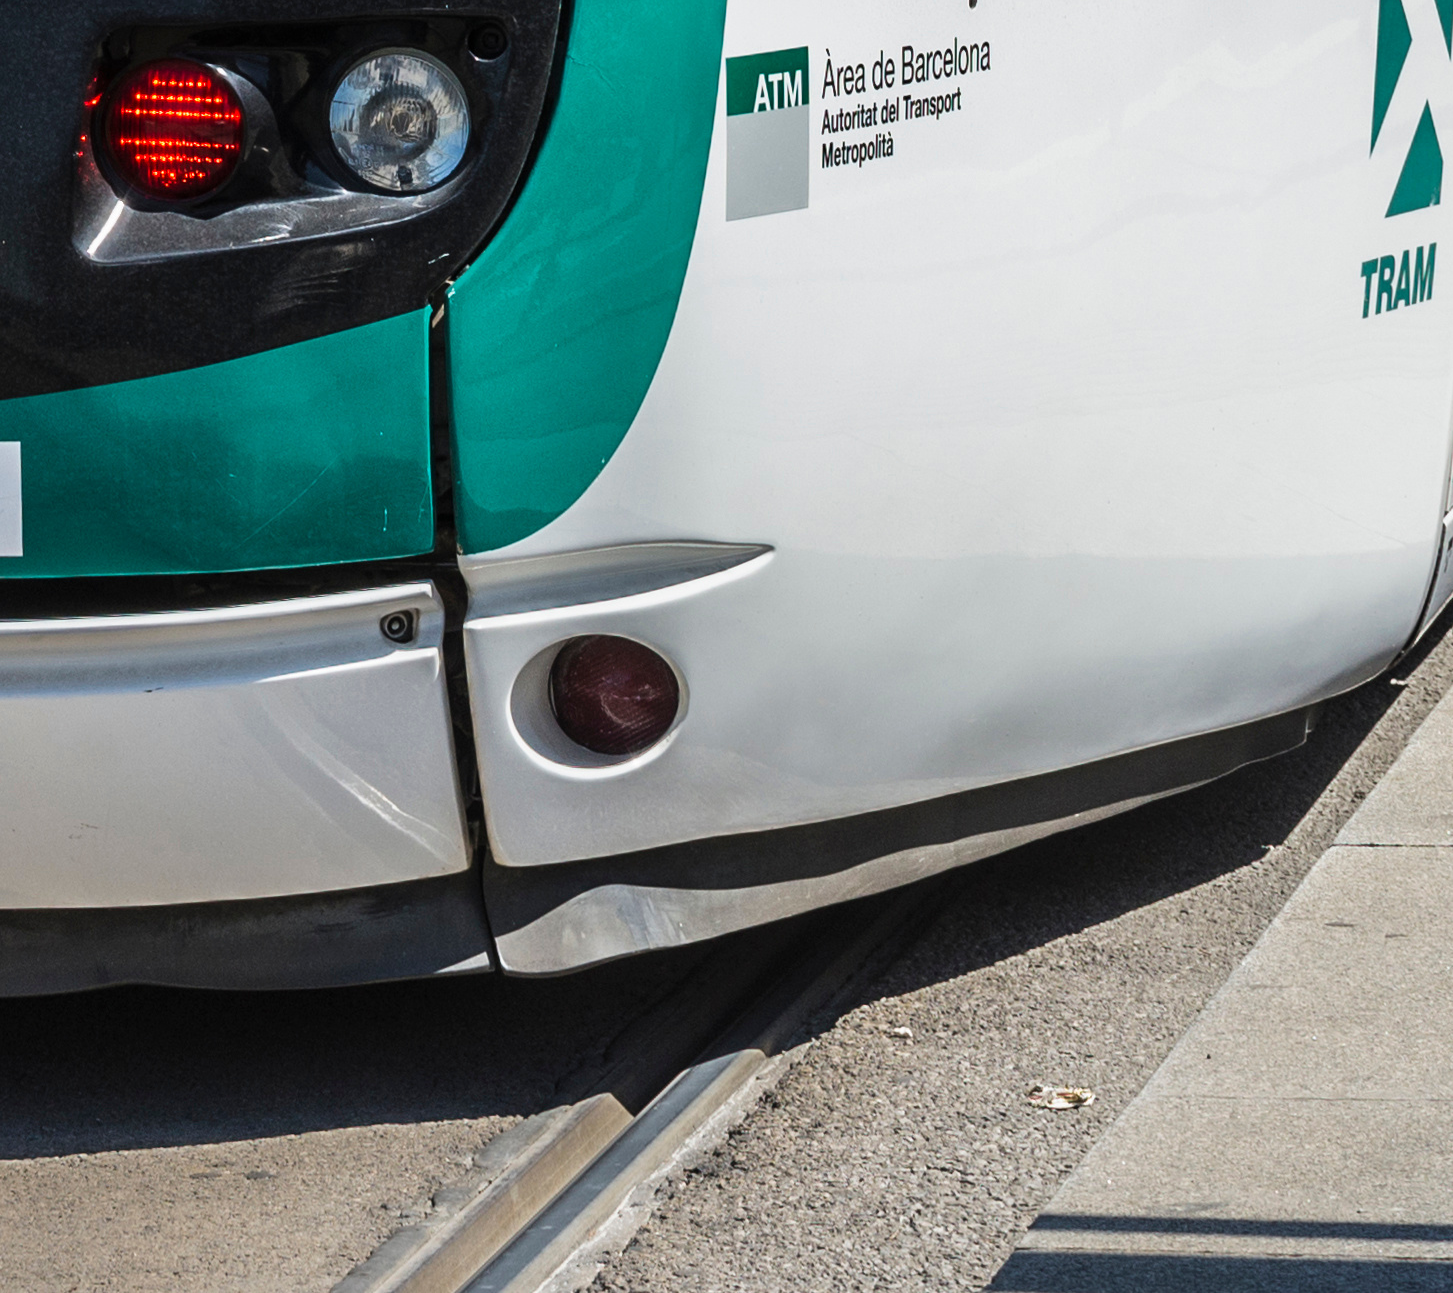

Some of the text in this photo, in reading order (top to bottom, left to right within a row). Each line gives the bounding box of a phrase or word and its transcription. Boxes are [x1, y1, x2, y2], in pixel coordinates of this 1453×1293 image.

[753, 69, 803, 113] ATM
[821, 37, 991, 99] Àrea de Barcelona
[821, 87, 962, 135] Autoritat del Transport
[821, 131, 894, 169] Metropolità
[1360, 242, 1437, 319] TRAM
